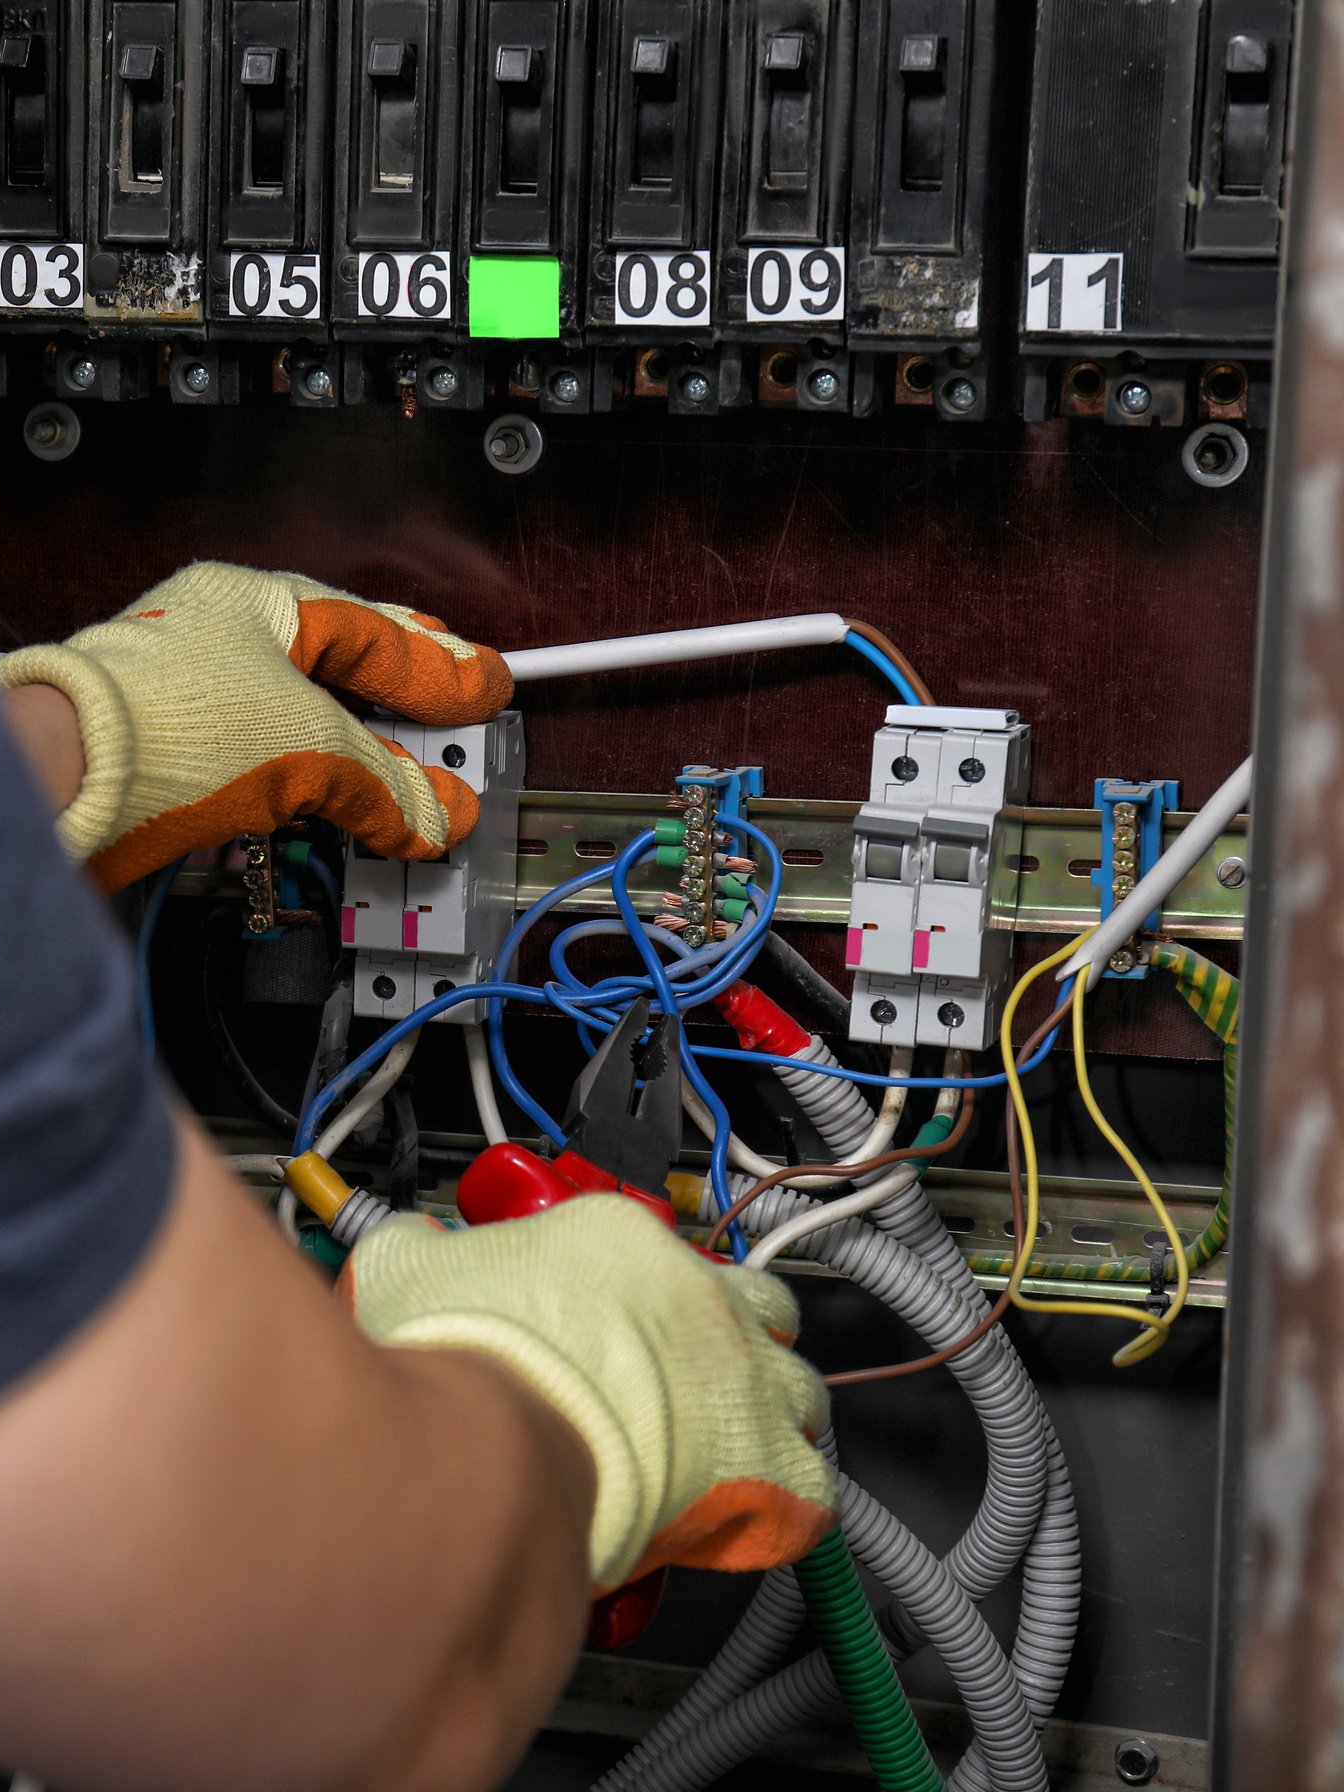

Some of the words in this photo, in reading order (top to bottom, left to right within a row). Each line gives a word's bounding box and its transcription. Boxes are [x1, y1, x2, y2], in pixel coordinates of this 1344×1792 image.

[0, 244, 81, 306] 03
[232, 253, 318, 316] 05
[361, 253, 447, 316] 06
[617, 253, 707, 318] 08
[750, 250, 842, 315] 09
[1030, 257, 1121, 329] 11
